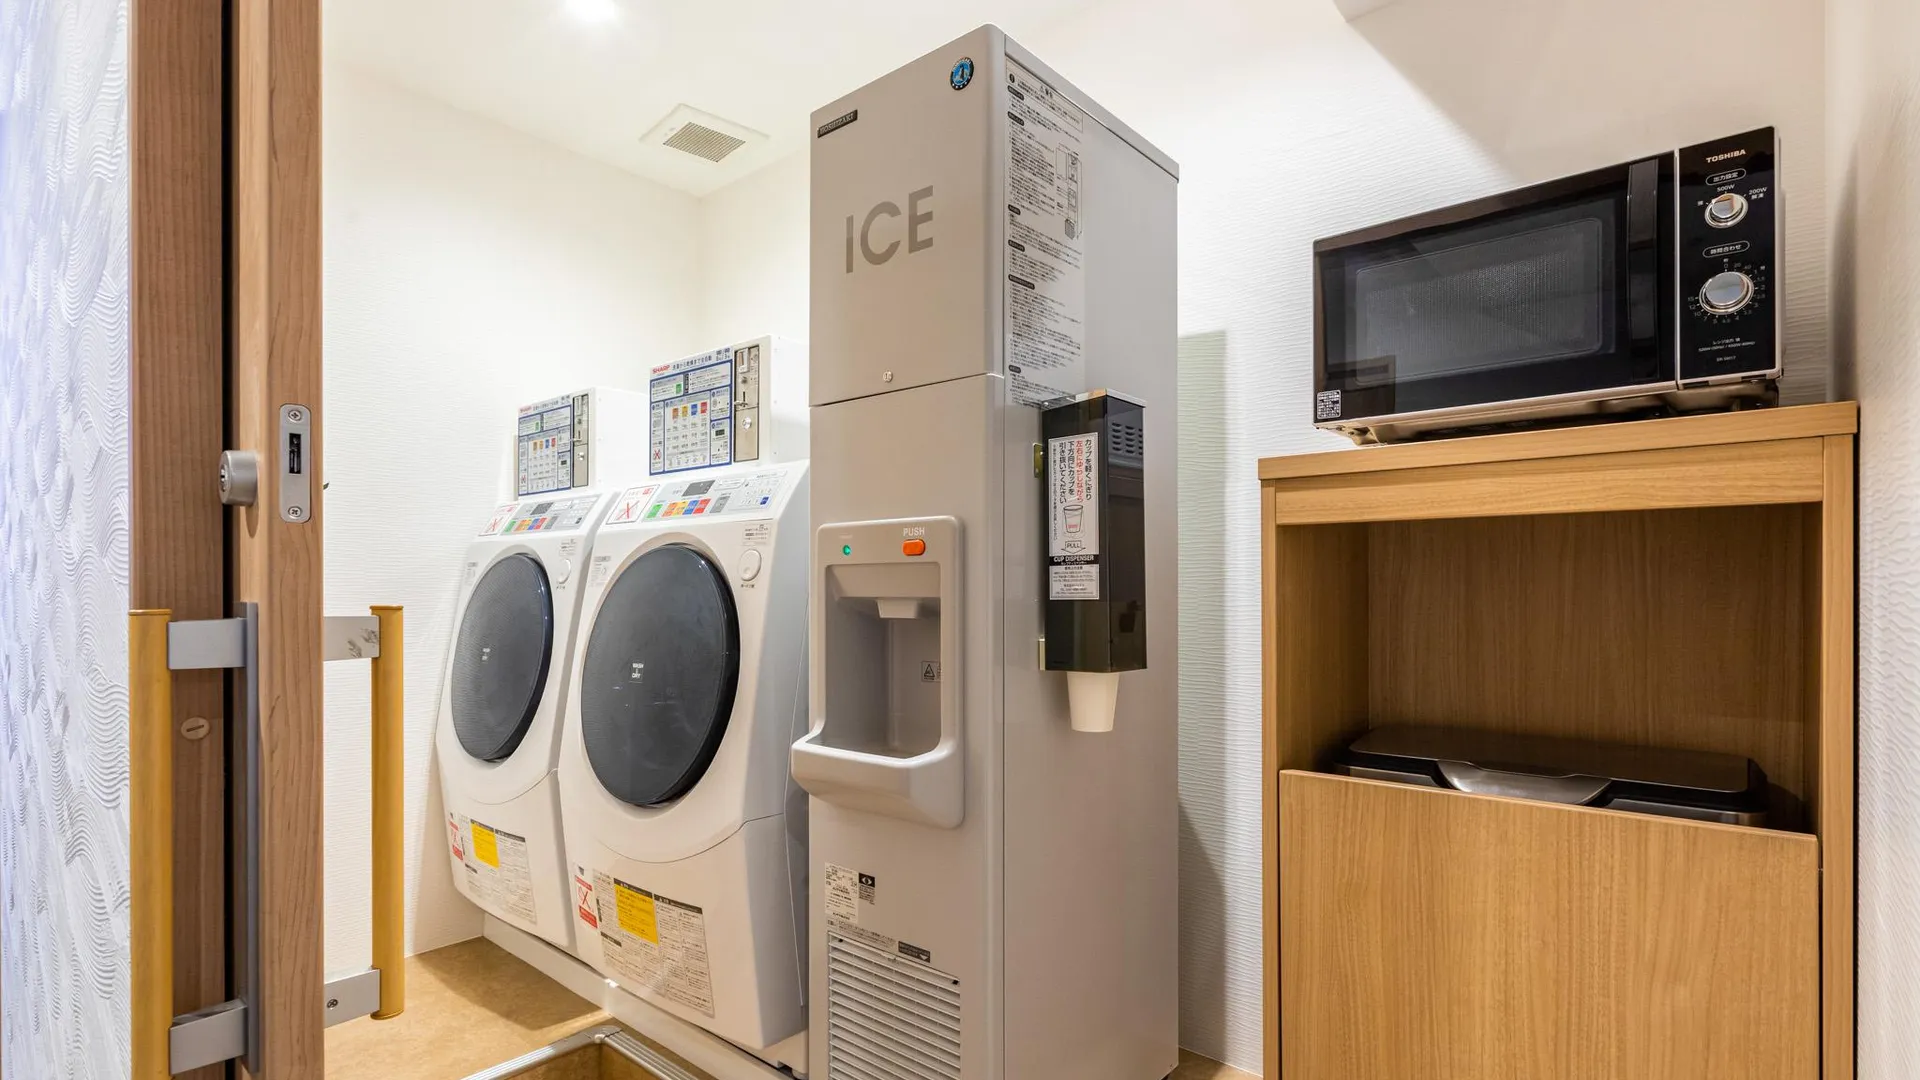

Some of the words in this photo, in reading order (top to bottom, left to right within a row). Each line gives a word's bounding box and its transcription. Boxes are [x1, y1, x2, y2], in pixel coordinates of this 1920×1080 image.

[1705, 149, 1747, 163] TOSHIBA
[1717, 184, 1735, 192] 500W
[1749, 187, 1767, 195] 200W
[846, 185, 934, 274] ICE
[1710, 245, 1742, 255] 時間合わせ
[652, 364, 671, 374] SHARP
[1067, 441, 1075, 495] 下方向にカップを
[903, 527, 925, 536] PUSH
